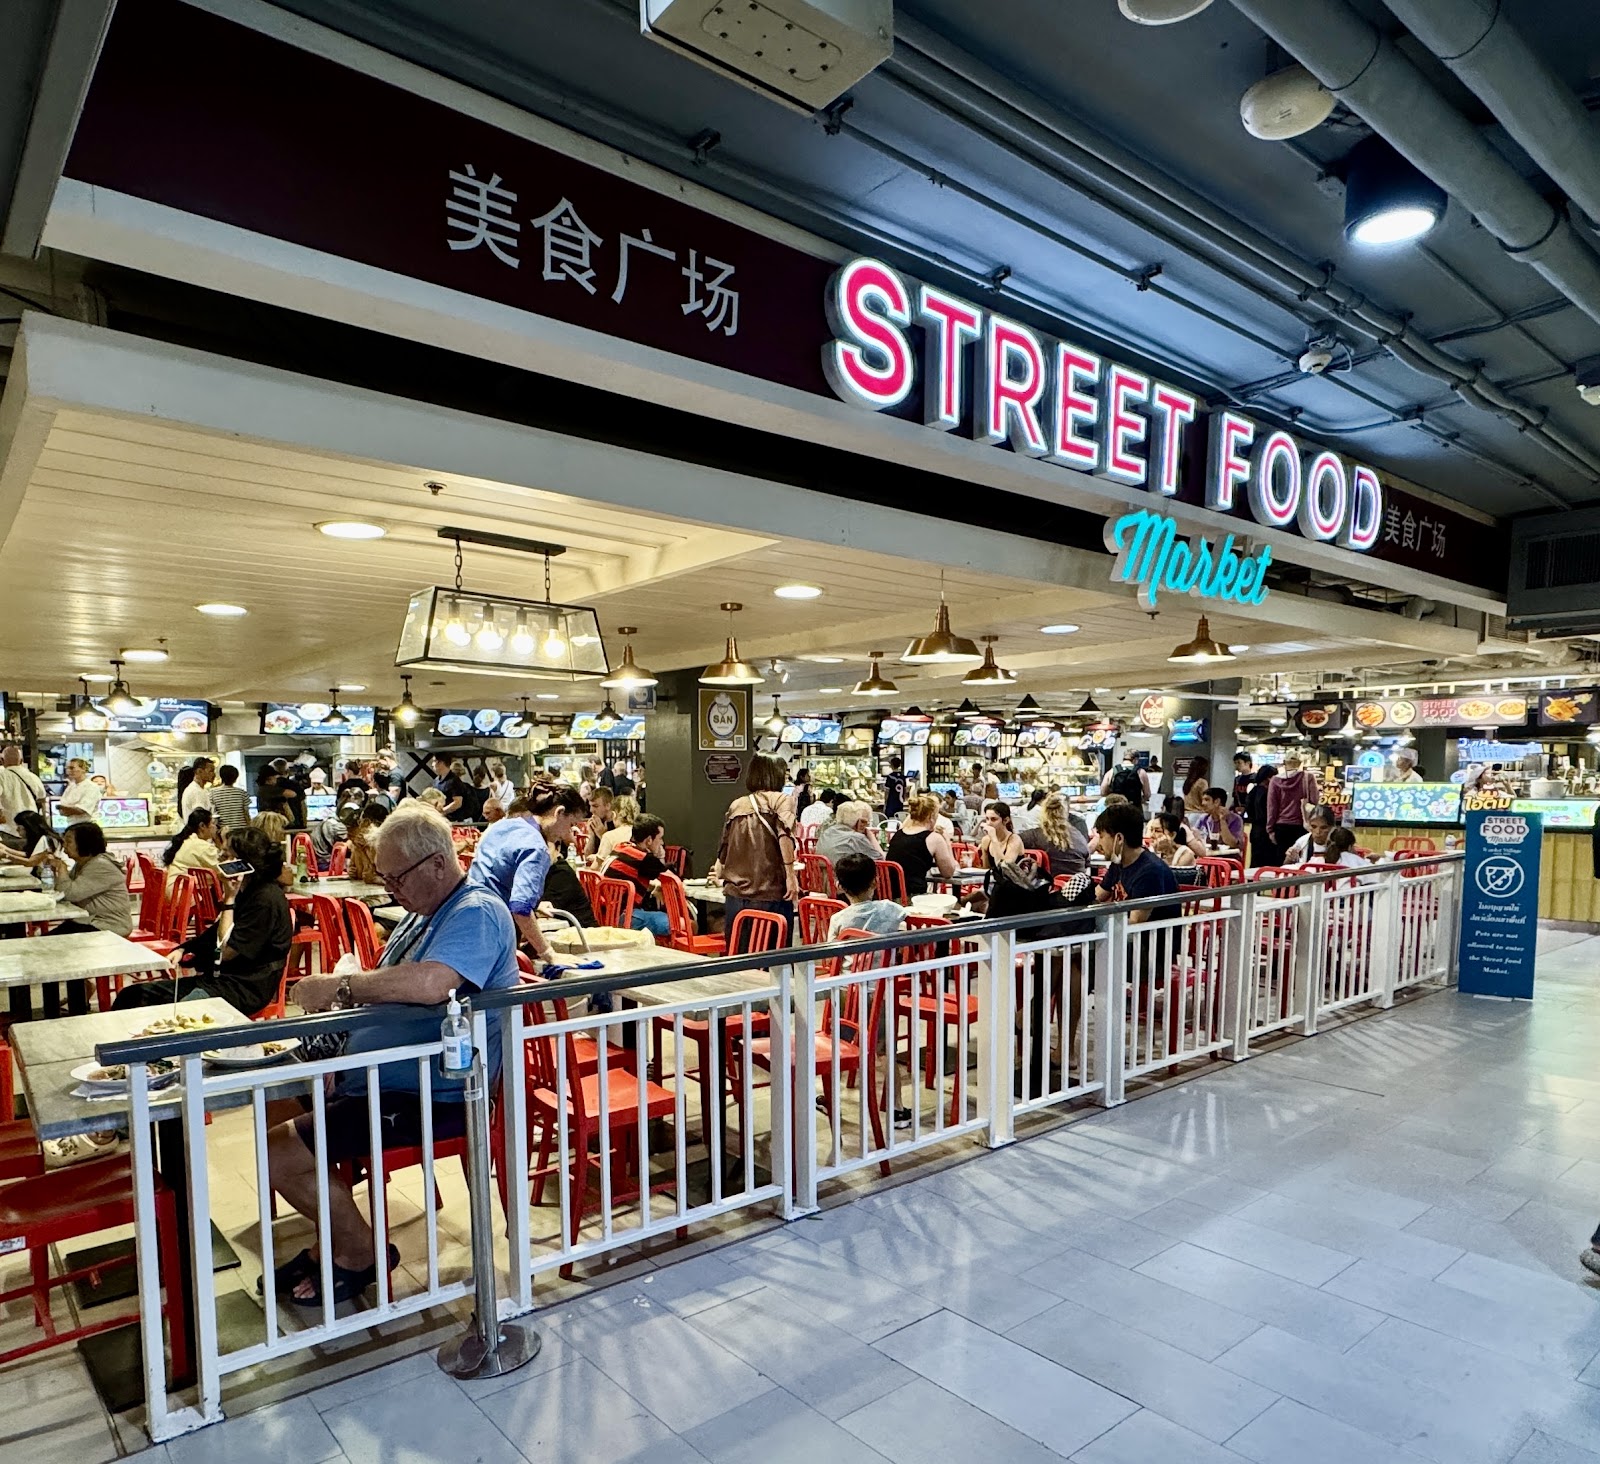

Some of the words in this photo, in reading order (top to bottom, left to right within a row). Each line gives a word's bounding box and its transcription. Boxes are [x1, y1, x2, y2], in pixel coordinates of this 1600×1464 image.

[446, 163, 740, 337] 美食广场
[835, 256, 1197, 497] STREET
[1216, 411, 1384, 551] FOOD
[1384, 504, 1447, 558] 美食广场
[1112, 508, 1273, 606] Market
[1422, 699, 1459, 709] STREET
[1422, 708, 1457, 718] FOOD
[713, 714, 733, 725] SAN
[1487, 817, 1523, 825] STREET
[1482, 824, 1526, 835] FOOD
[1467, 941, 1494, 949] allowed
[1482, 955, 1503, 963] Street
